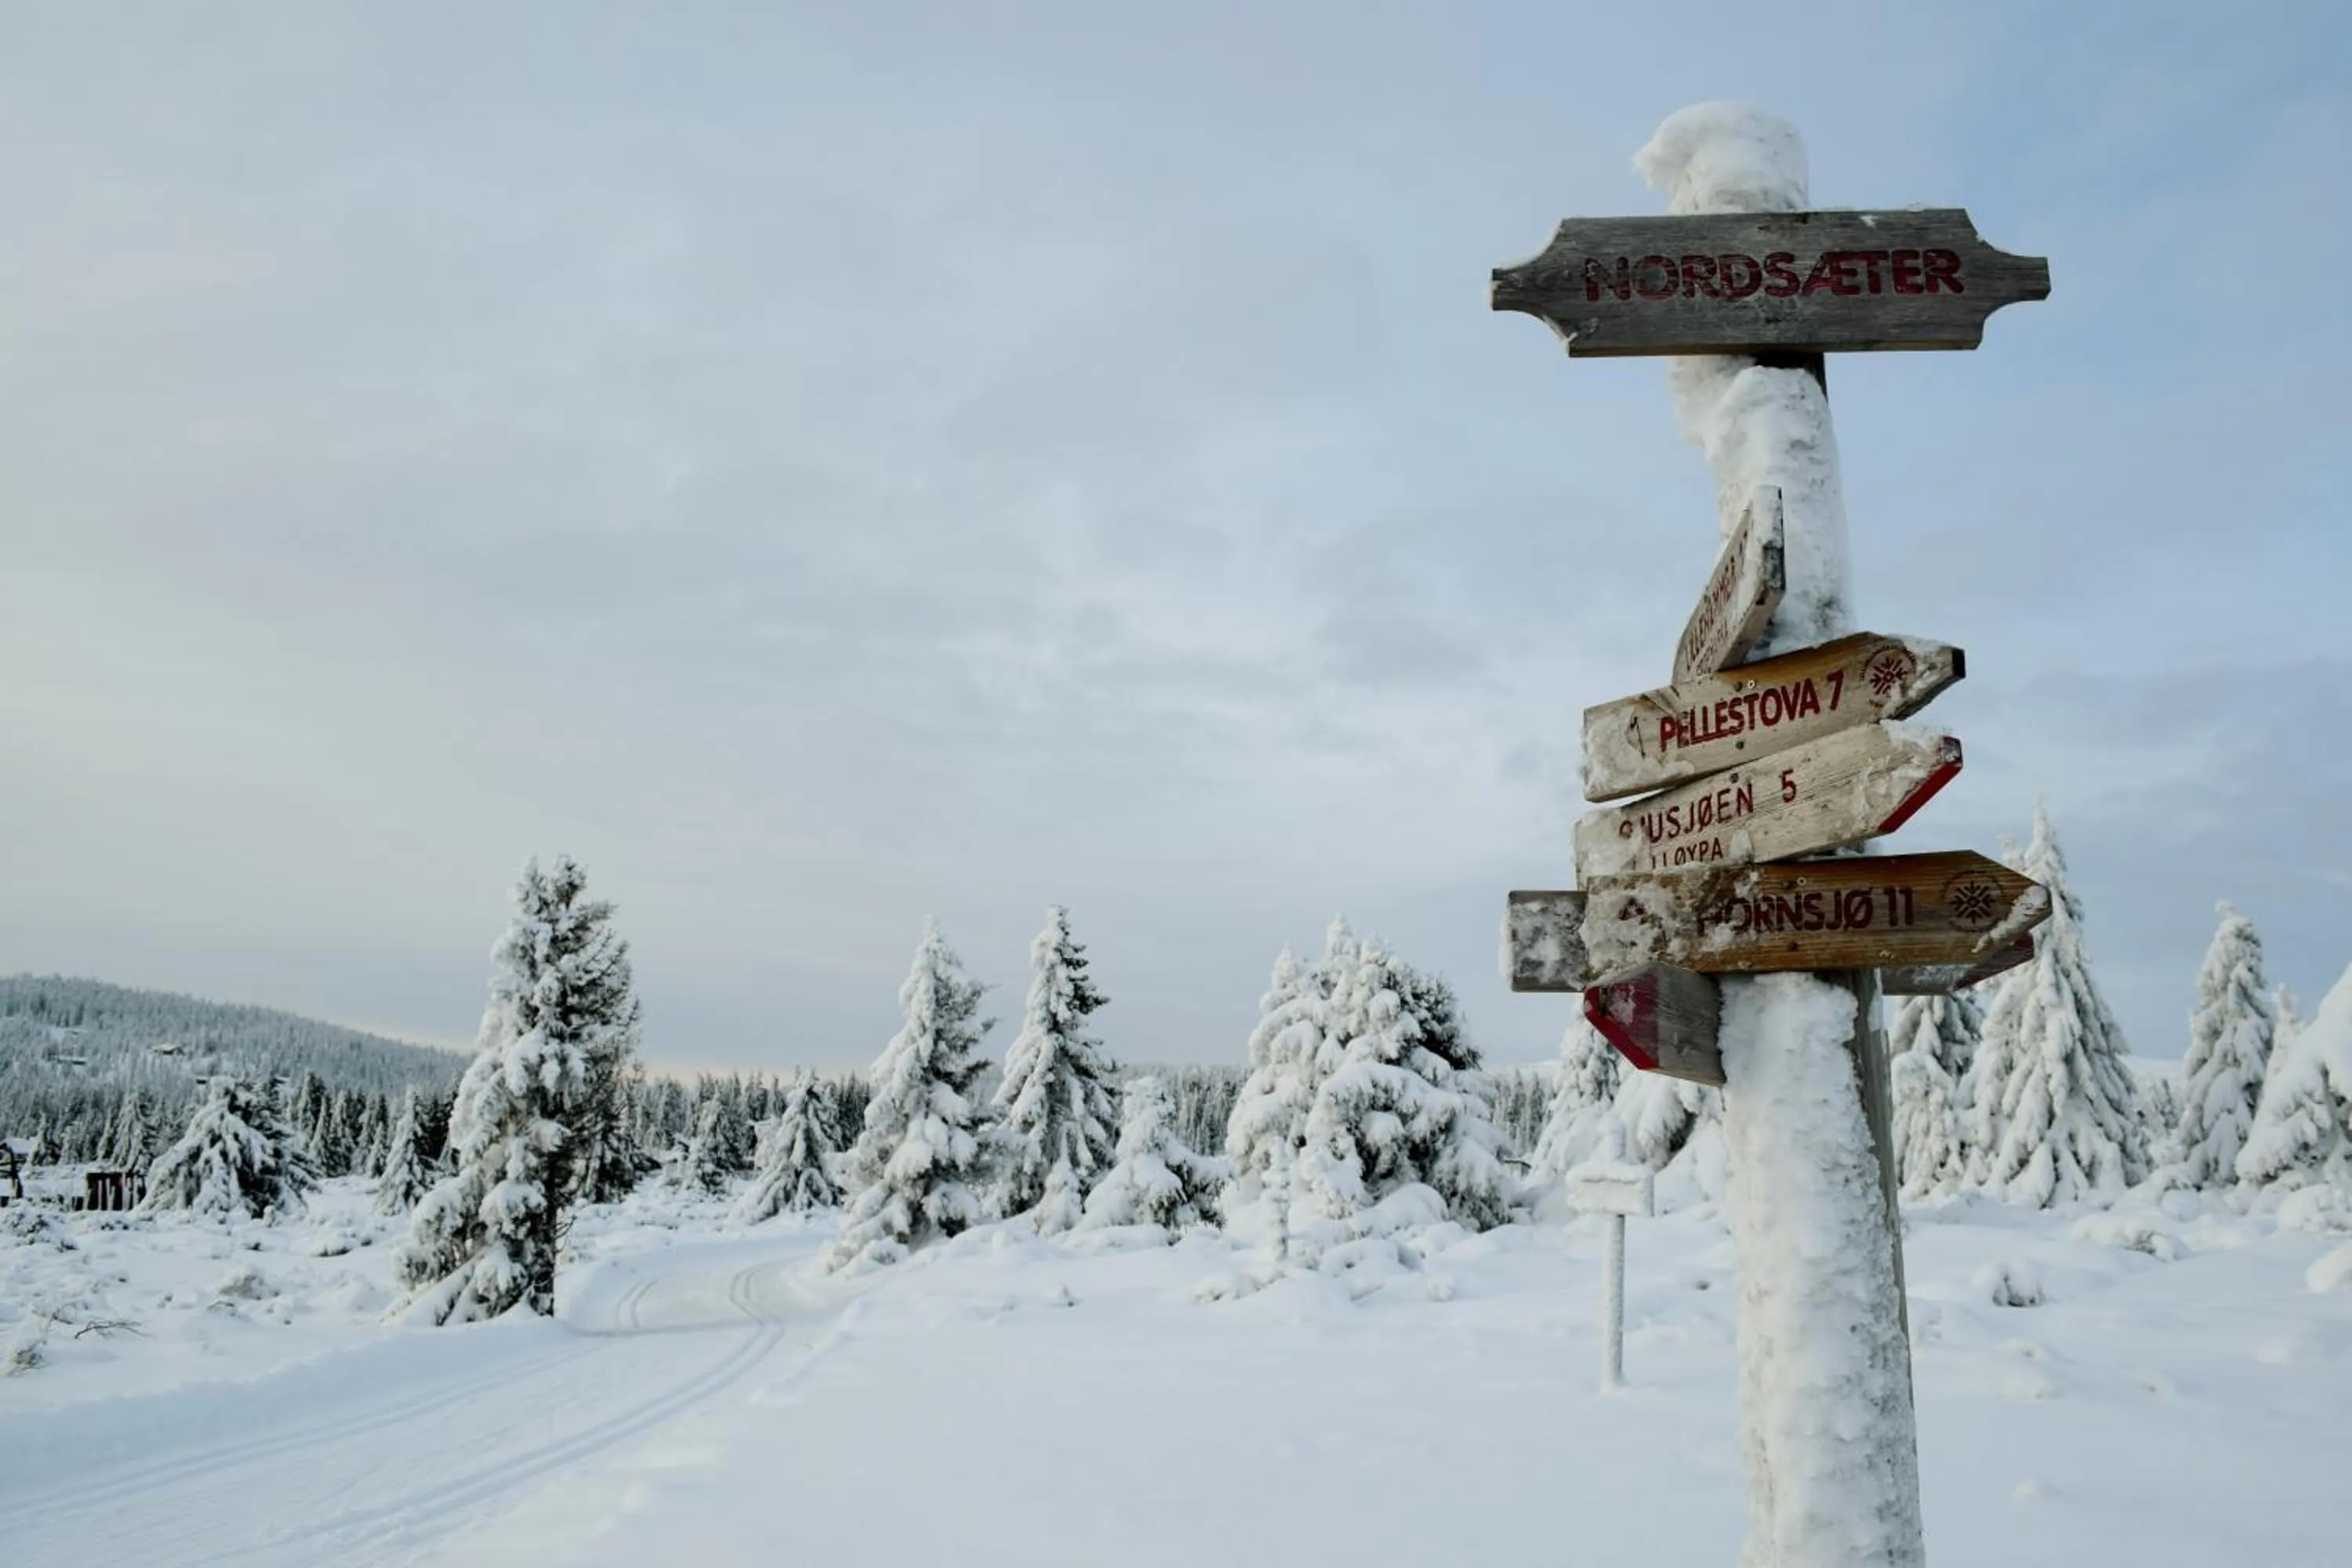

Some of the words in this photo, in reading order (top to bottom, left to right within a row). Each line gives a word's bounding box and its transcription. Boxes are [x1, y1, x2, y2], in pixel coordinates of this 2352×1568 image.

[1584, 249, 1965, 302] NORDSÆTER
[1660, 677, 1821, 753] PELLESTOVA
[1827, 669, 1844, 711] 7
[1781, 768, 1796, 804] 5
[1883, 884, 1915, 927] 11
